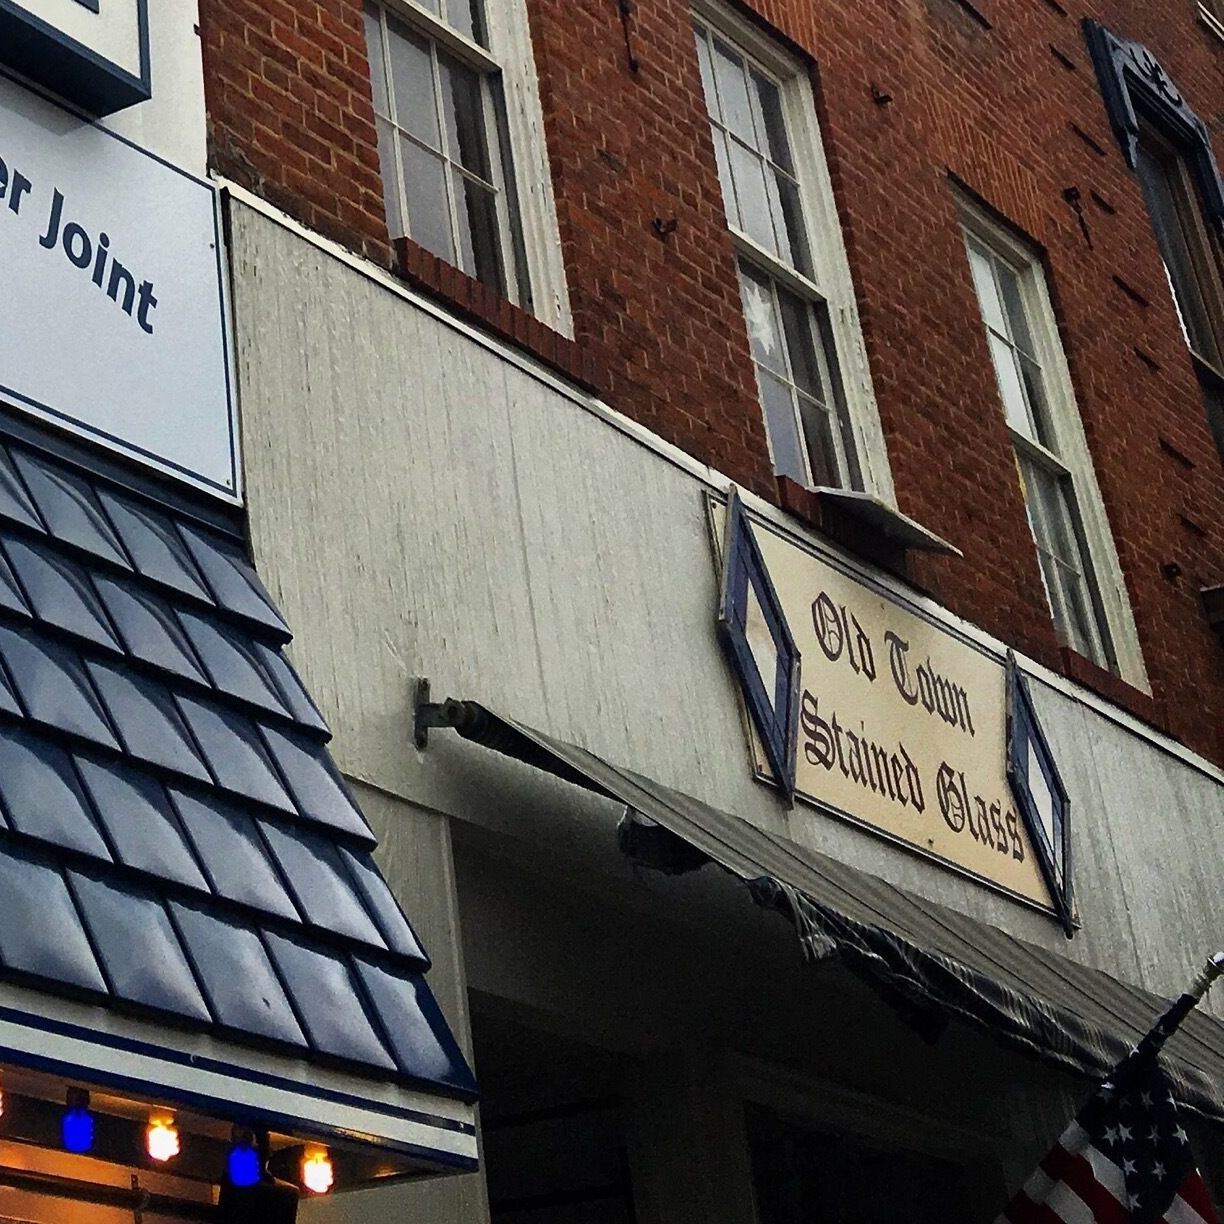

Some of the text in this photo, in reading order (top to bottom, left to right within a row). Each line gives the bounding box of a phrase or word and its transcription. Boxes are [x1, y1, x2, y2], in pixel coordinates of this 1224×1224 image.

[40, 187, 159, 334] Joint
[811, 590, 975, 737] Old Town
[800, 688, 1026, 863] Stained Glass
